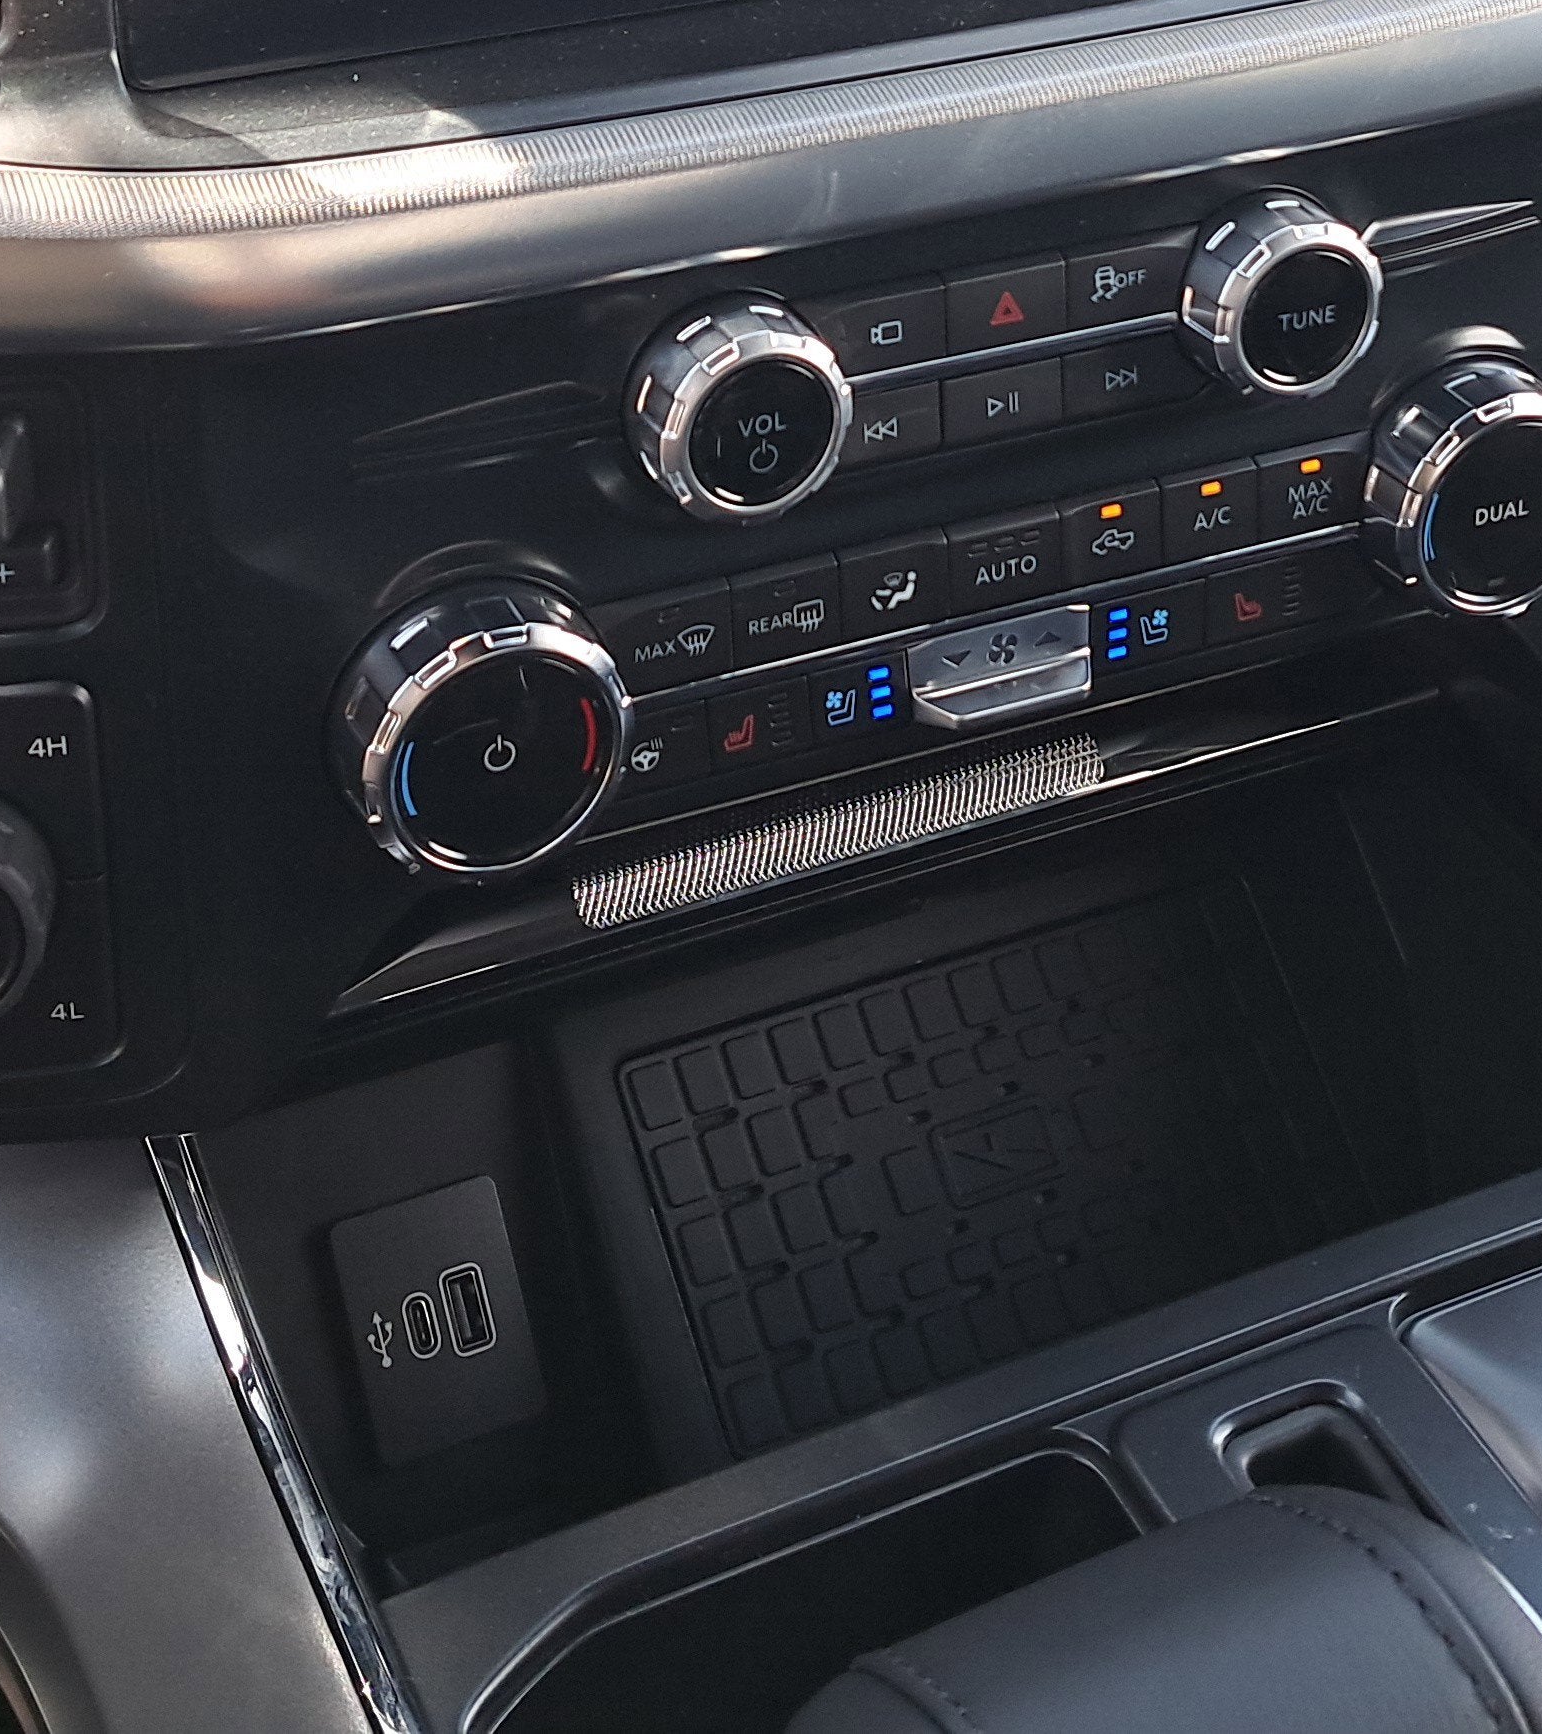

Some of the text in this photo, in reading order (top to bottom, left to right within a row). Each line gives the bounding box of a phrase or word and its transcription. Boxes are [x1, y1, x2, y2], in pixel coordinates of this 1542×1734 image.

[1114, 268, 1147, 288] OFF
[1277, 304, 1336, 332] TUNE
[737, 412, 788, 437] VOL
[1288, 478, 1333, 503] MAX
[1193, 504, 1232, 532] A/C
[1292, 495, 1329, 520] A/C
[1474, 499, 1529, 527] DUAL
[975, 556, 1037, 585] AUTO
[748, 611, 792, 636] REAR
[634, 640, 676, 663] MAX
[27, 735, 68, 757] 4H
[50, 1002, 85, 1021] 4L
